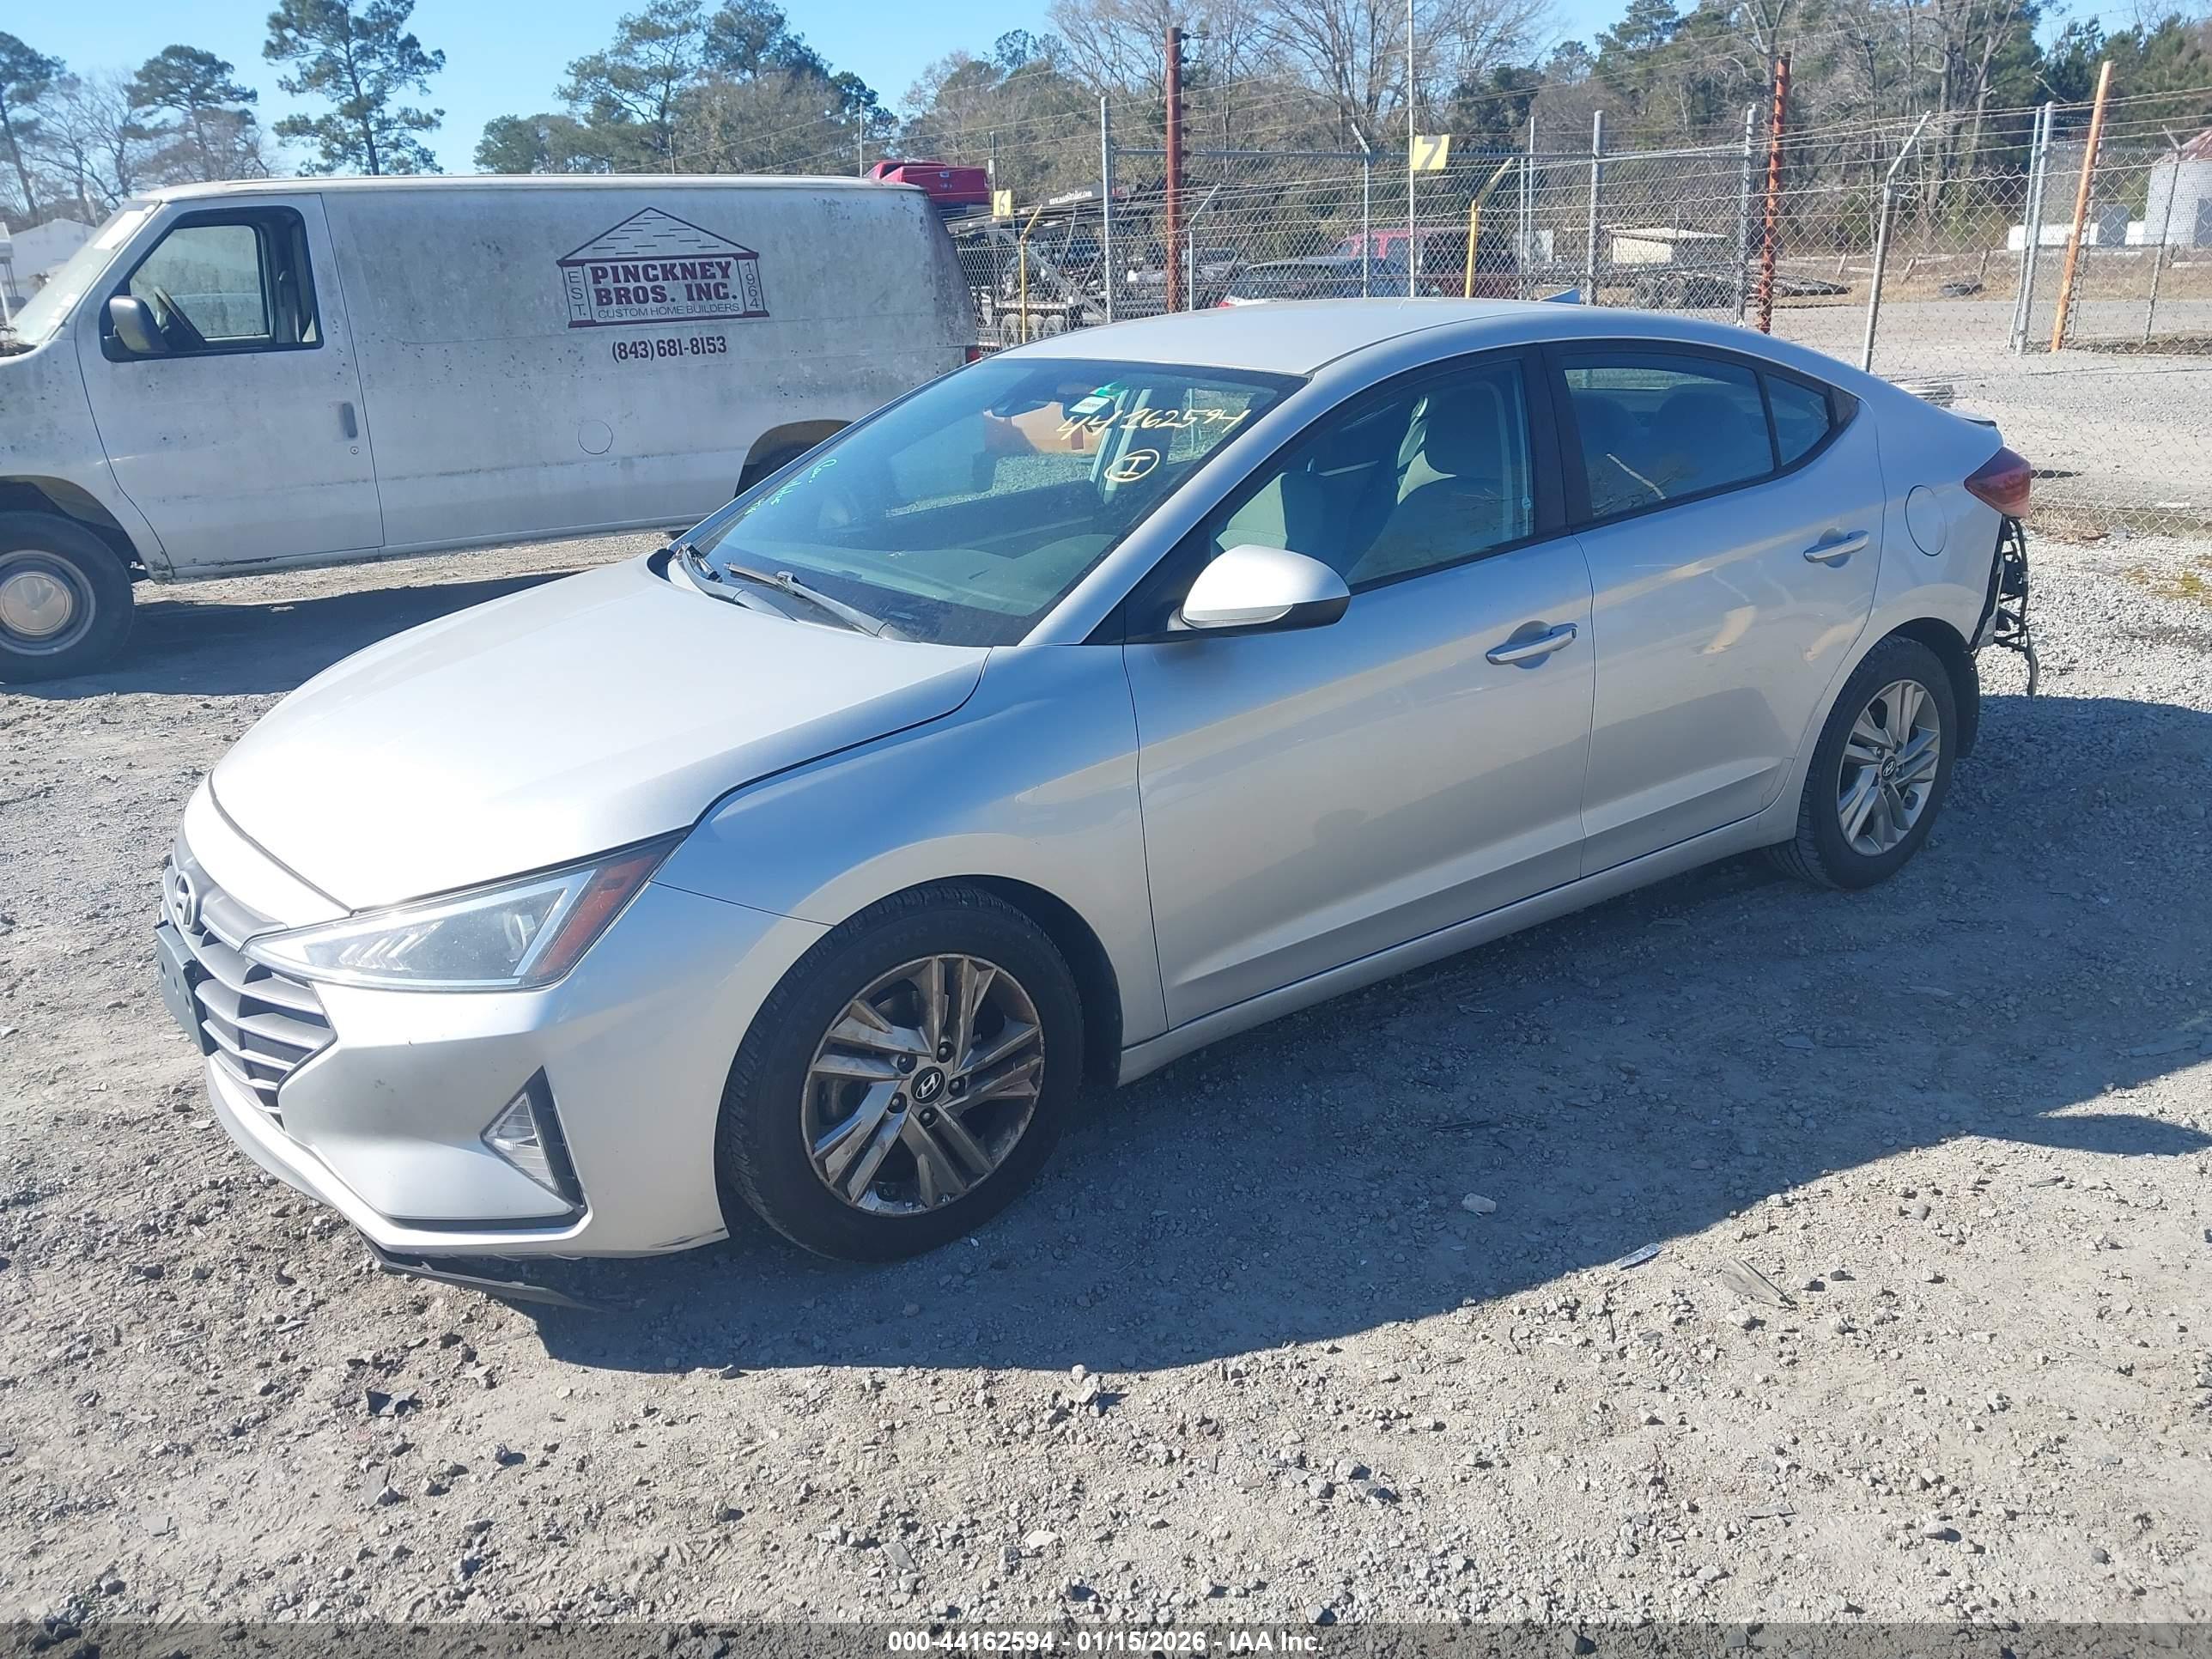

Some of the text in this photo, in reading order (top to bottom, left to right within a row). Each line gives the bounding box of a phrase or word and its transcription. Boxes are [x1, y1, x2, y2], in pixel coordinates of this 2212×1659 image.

[1420, 136, 1443, 169] 7
[999, 191, 1007, 215] 6
[590, 260, 732, 284] PINCKNEY
[744, 261, 761, 309] 1964
[567, 271, 587, 317] EST.
[593, 282, 738, 307] BROS. INC.
[598, 302, 740, 319] CUSTOM HOME BUILDERS
[611, 336, 727, 363] (843) 681-8153
